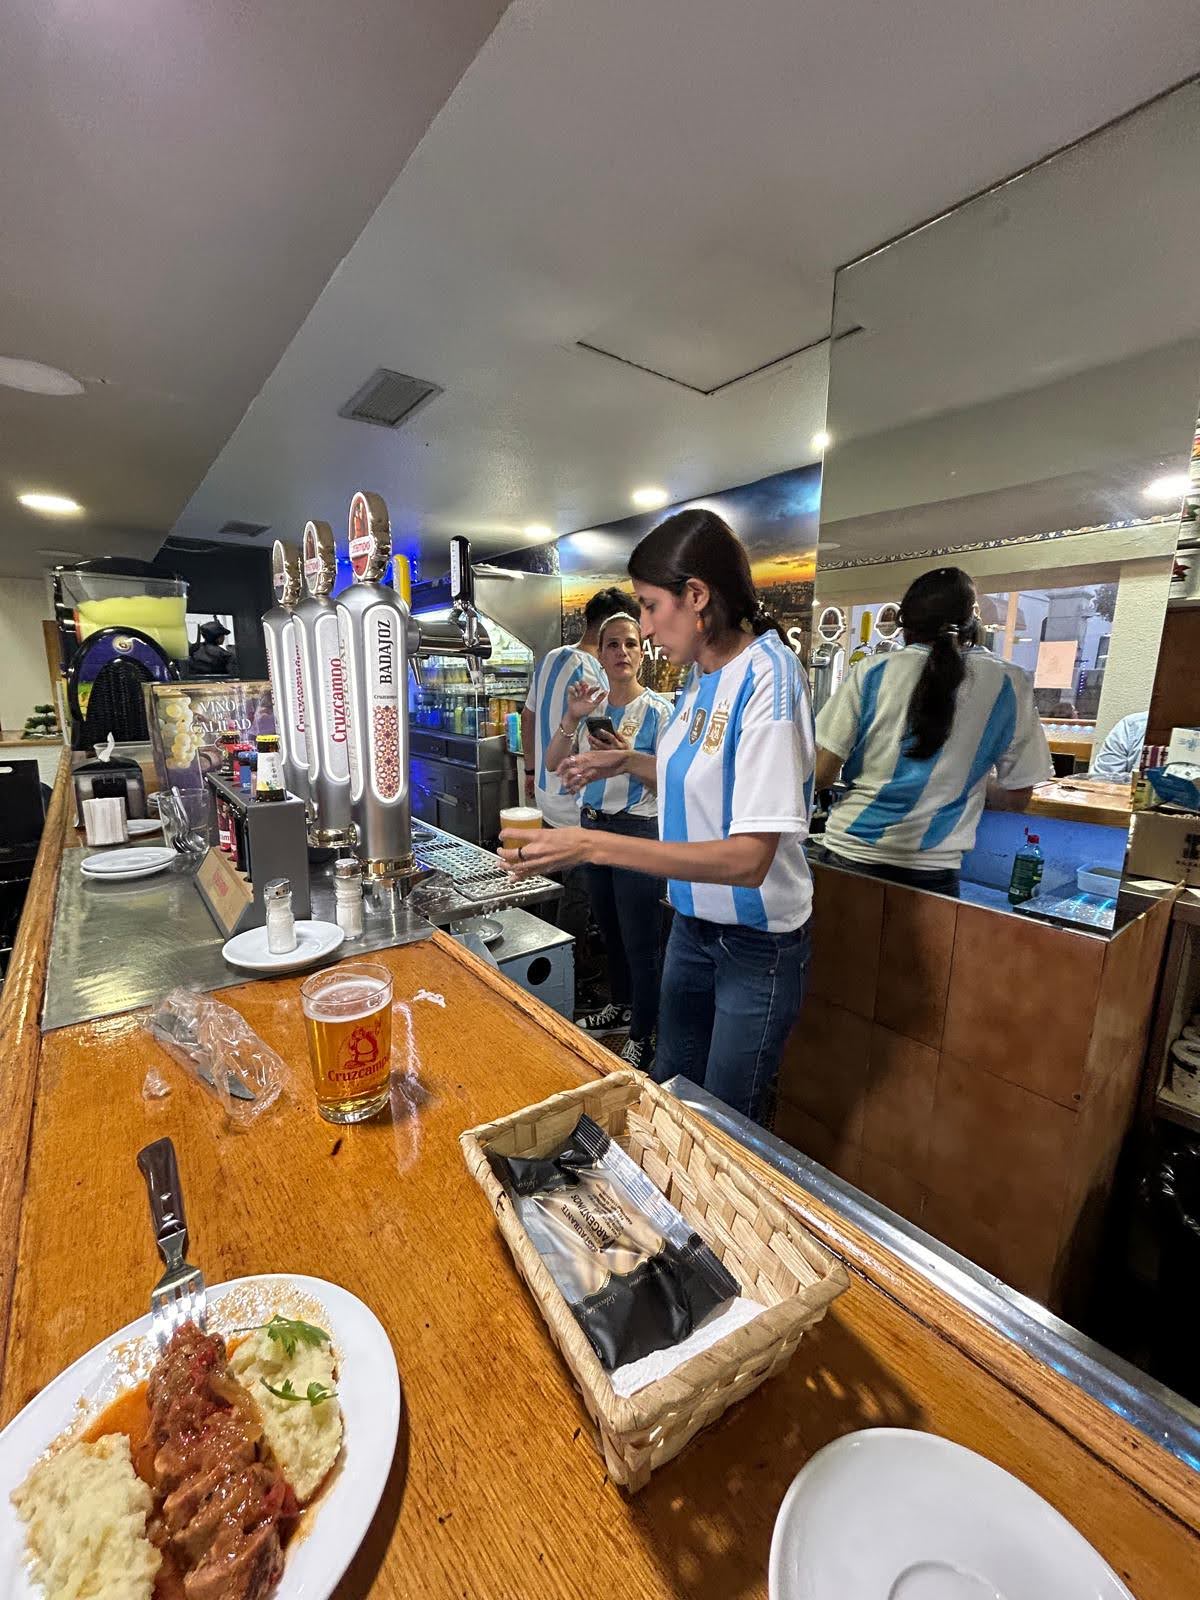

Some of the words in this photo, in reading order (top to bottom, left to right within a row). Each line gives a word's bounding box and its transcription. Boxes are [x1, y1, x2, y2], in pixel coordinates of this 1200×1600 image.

[378, 620, 394, 685] BADAJOZ
[199, 700, 236, 713] VINO
[190, 718, 252, 733] CALIAD
